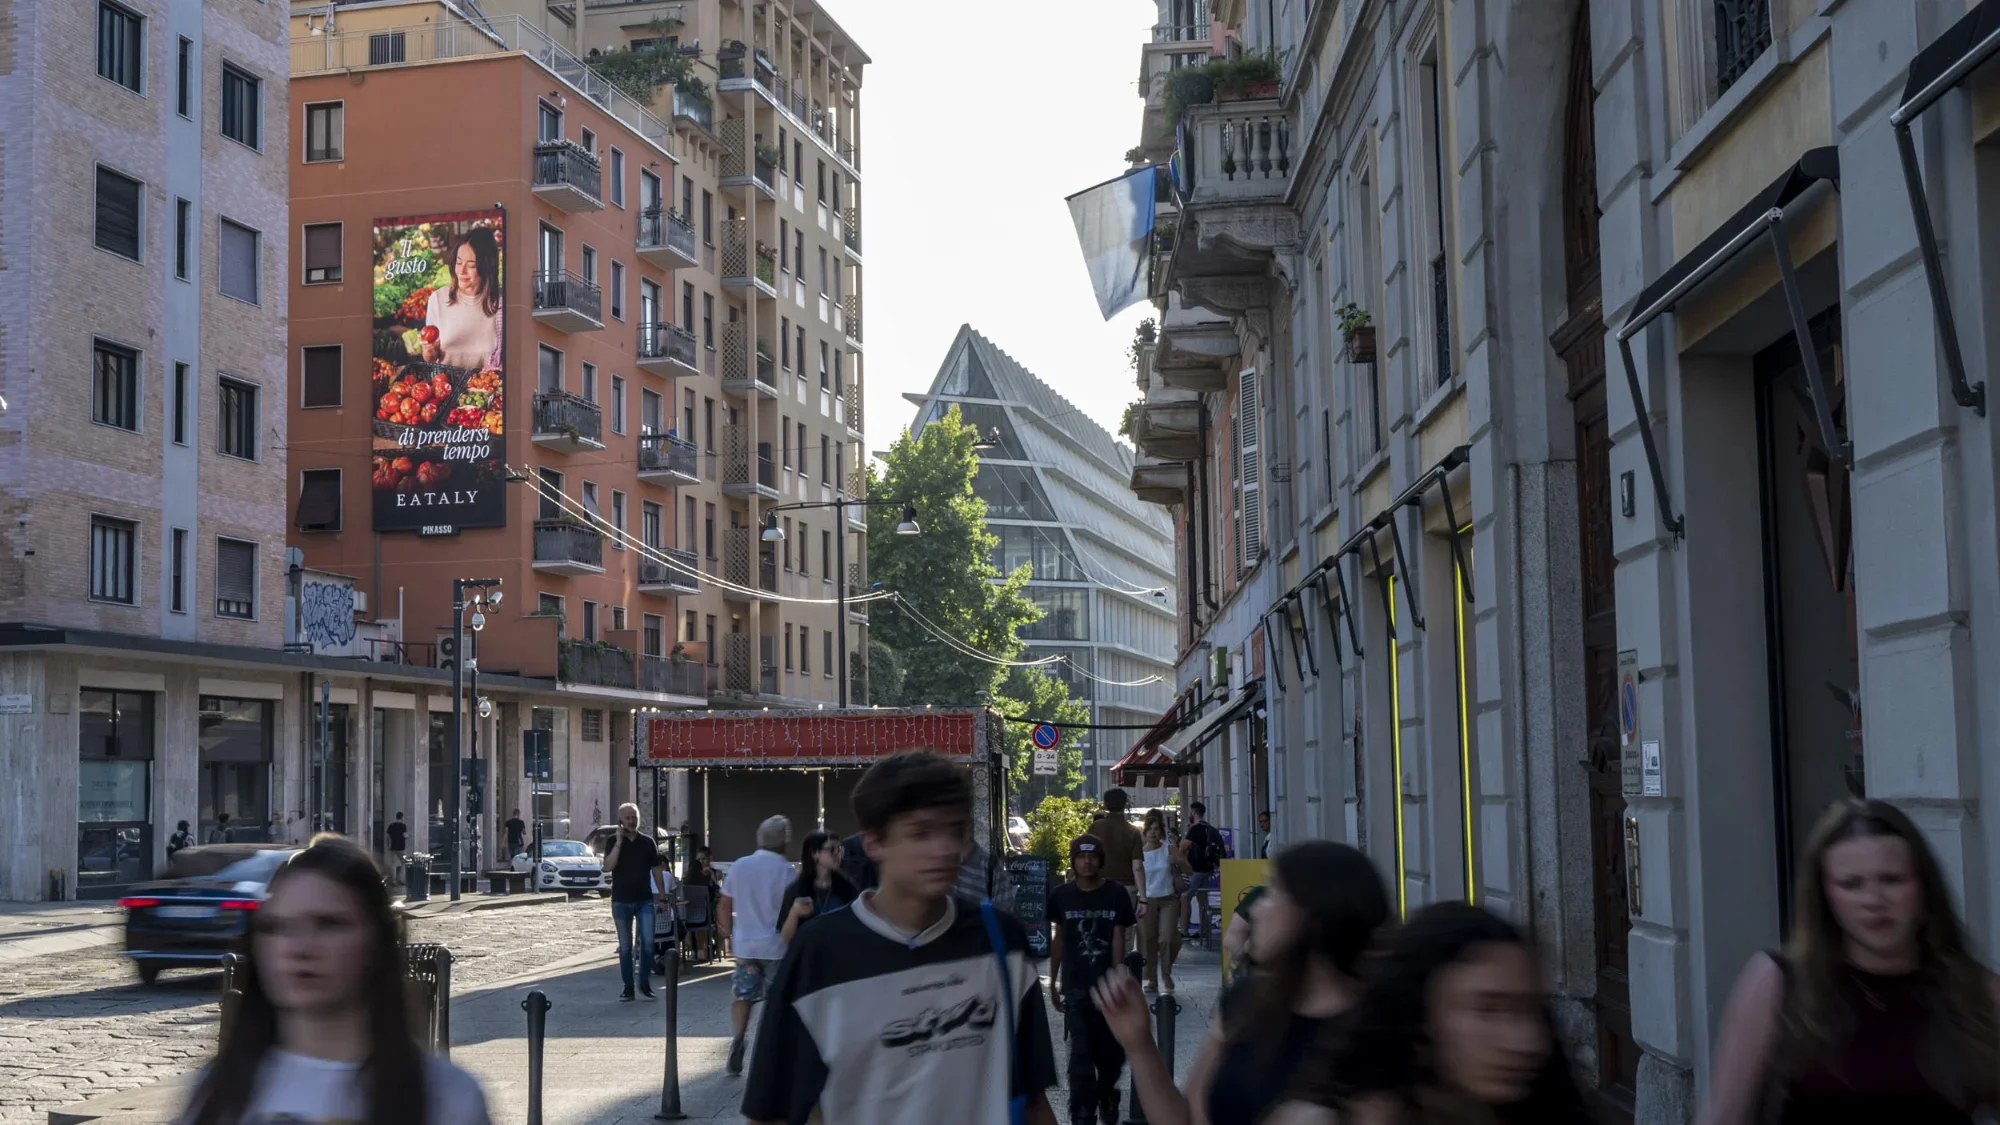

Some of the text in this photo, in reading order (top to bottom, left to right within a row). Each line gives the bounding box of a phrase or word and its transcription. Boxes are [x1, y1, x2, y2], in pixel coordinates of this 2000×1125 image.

[401, 239, 413, 258] Il
[386, 257, 427, 280] gusto
[398, 424, 490, 450] di prendersi
[443, 444, 490, 464] tempo
[396, 490, 479, 507] EATALY
[422, 525, 453, 535] PIKASSO
